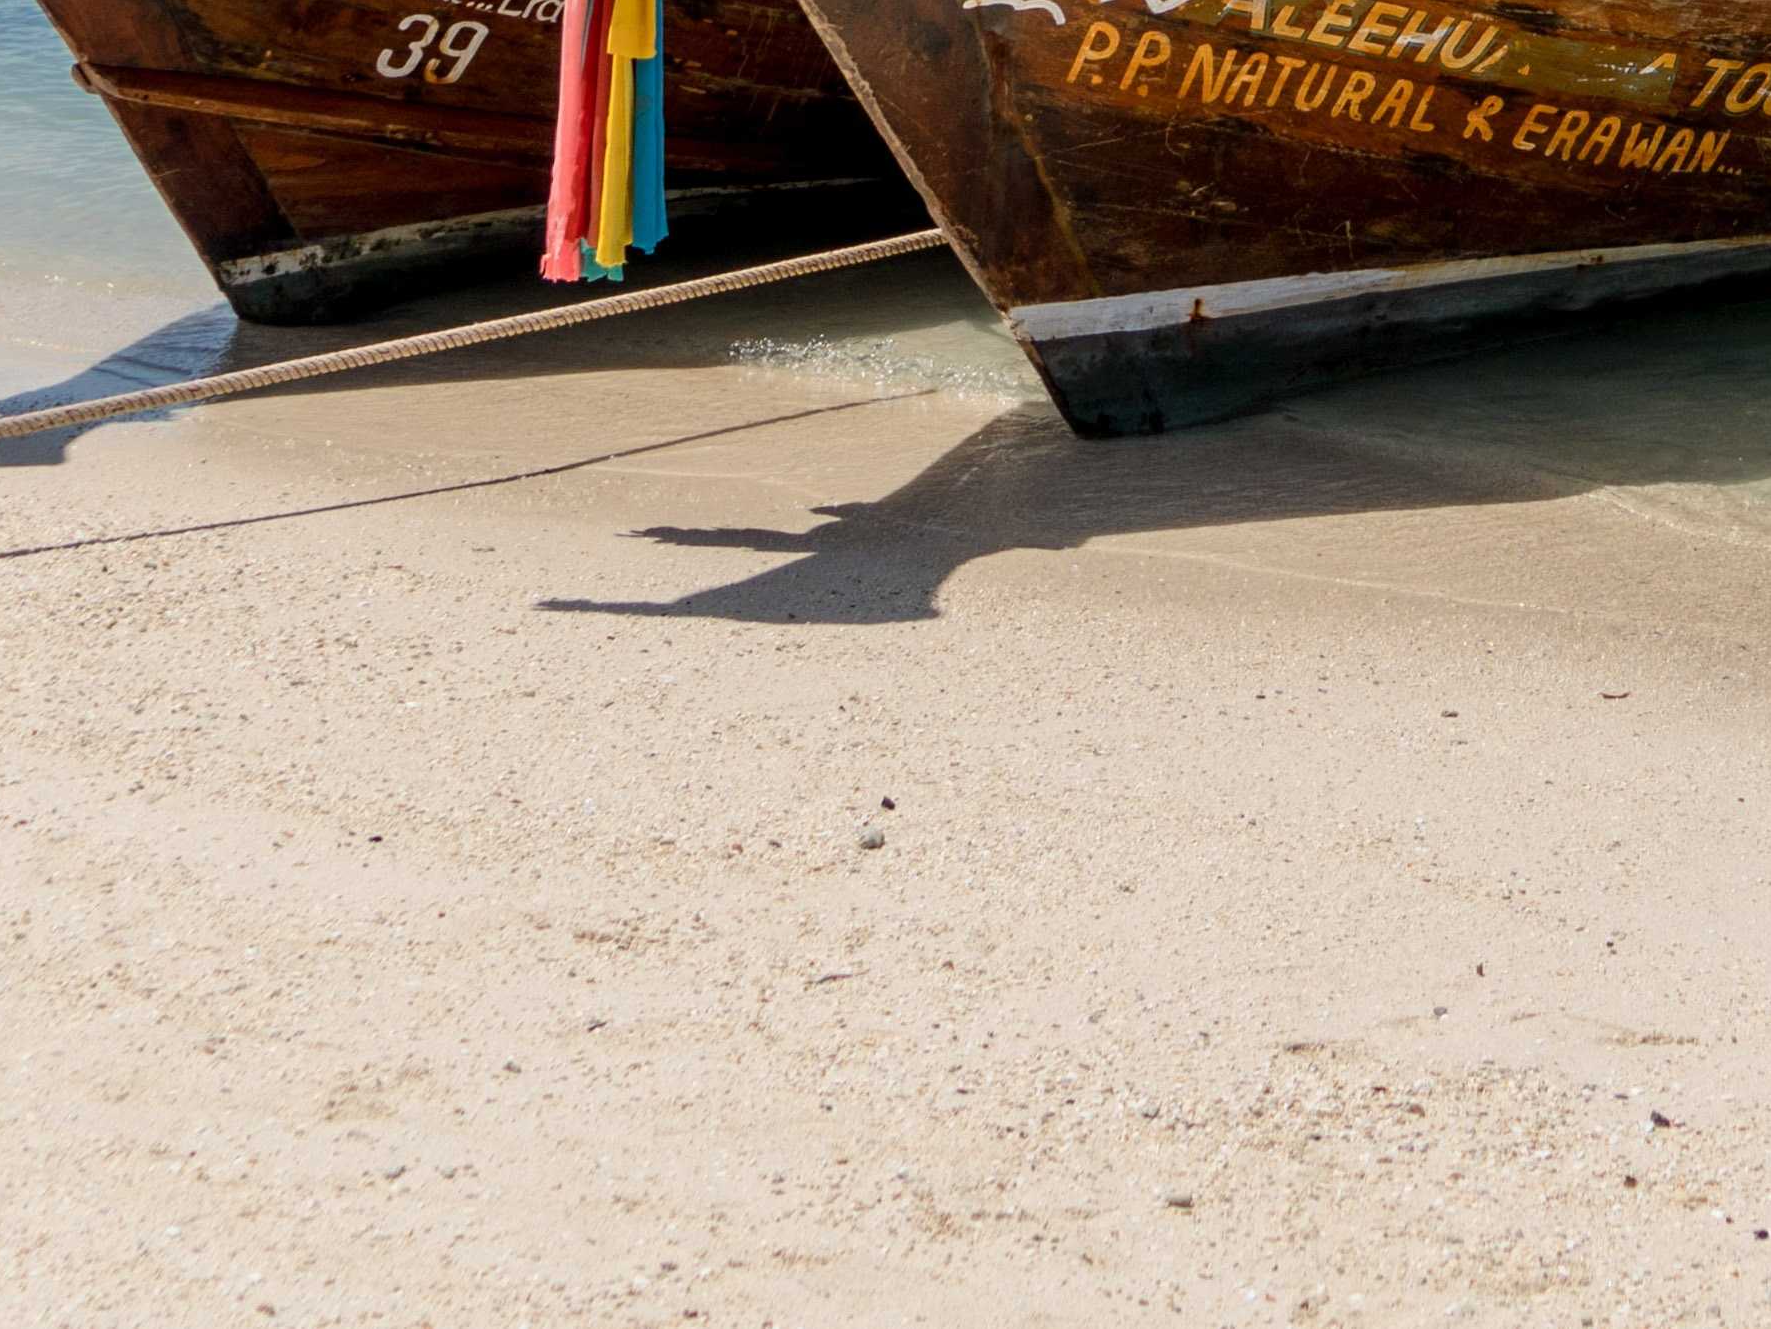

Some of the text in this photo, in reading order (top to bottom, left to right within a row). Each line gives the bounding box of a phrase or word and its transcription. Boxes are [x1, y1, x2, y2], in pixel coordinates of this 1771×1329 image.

[375, 13, 490, 85] 39
[1176, 43, 1436, 133] NATURAL
[1463, 94, 1505, 142] &
